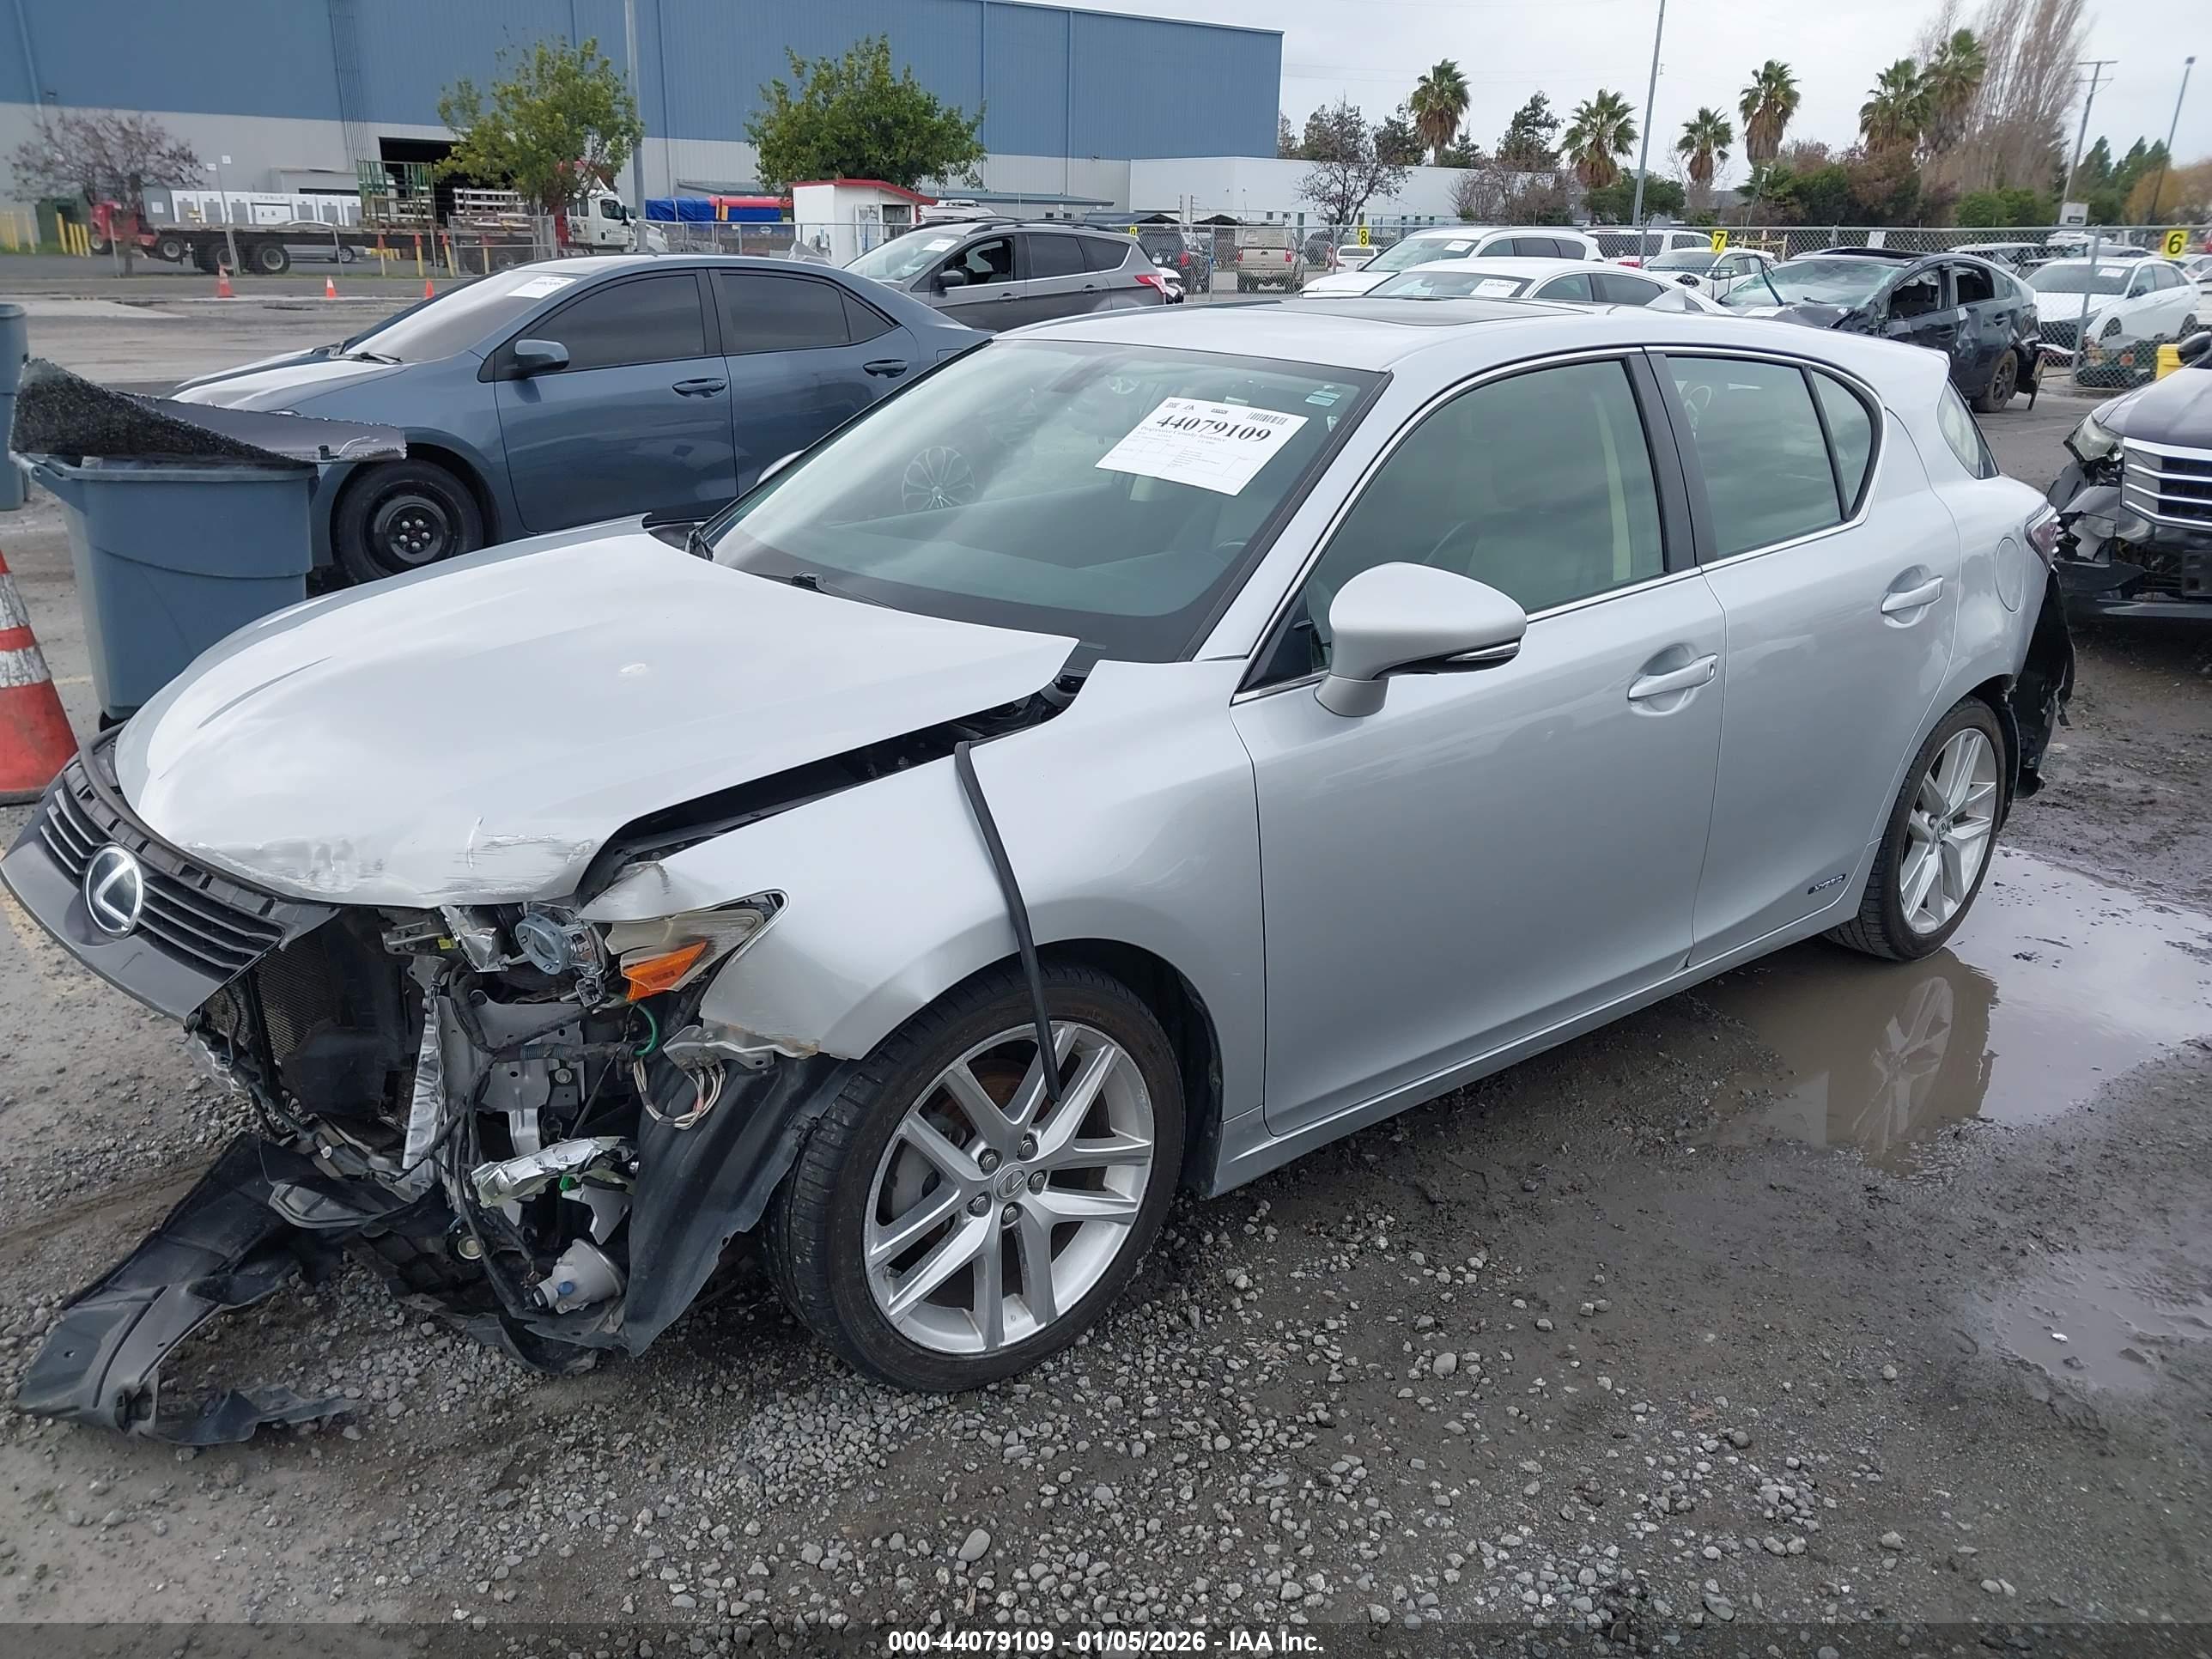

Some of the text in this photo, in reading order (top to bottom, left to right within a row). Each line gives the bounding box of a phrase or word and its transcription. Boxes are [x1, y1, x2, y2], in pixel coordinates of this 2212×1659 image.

[1360, 230, 1368, 245] 8
[1715, 233, 1726, 251] 7
[2168, 233, 2184, 254] 6
[1156, 414, 1272, 442] 44079109
